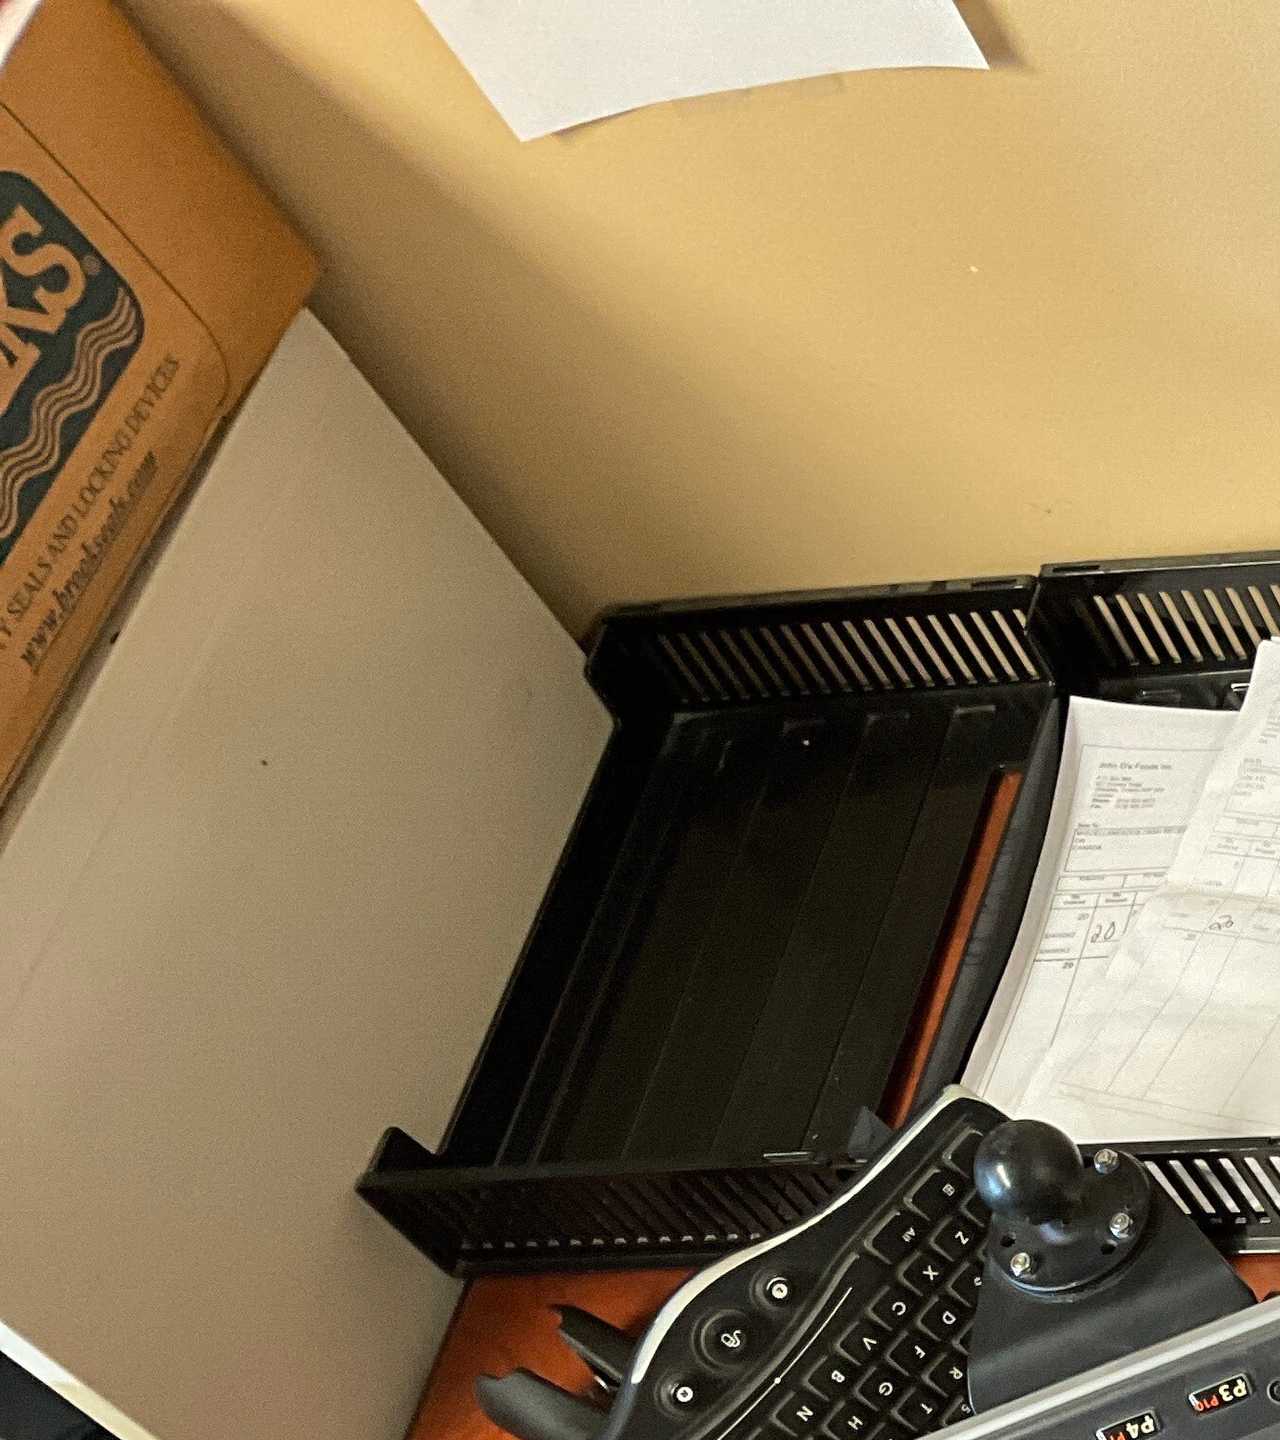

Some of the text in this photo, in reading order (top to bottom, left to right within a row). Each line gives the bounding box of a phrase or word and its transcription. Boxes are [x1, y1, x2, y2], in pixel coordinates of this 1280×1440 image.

[6, 352, 180, 620] SEALS AND LOCKING DEVICES
[1090, 921, 1116, 943] 20
[942, 1312, 956, 1326] D
[878, 1382, 894, 1397] G
[1218, 1376, 1248, 1401] P3
[797, 1406, 814, 1422] N
[1125, 1415, 1155, 1440] P4
